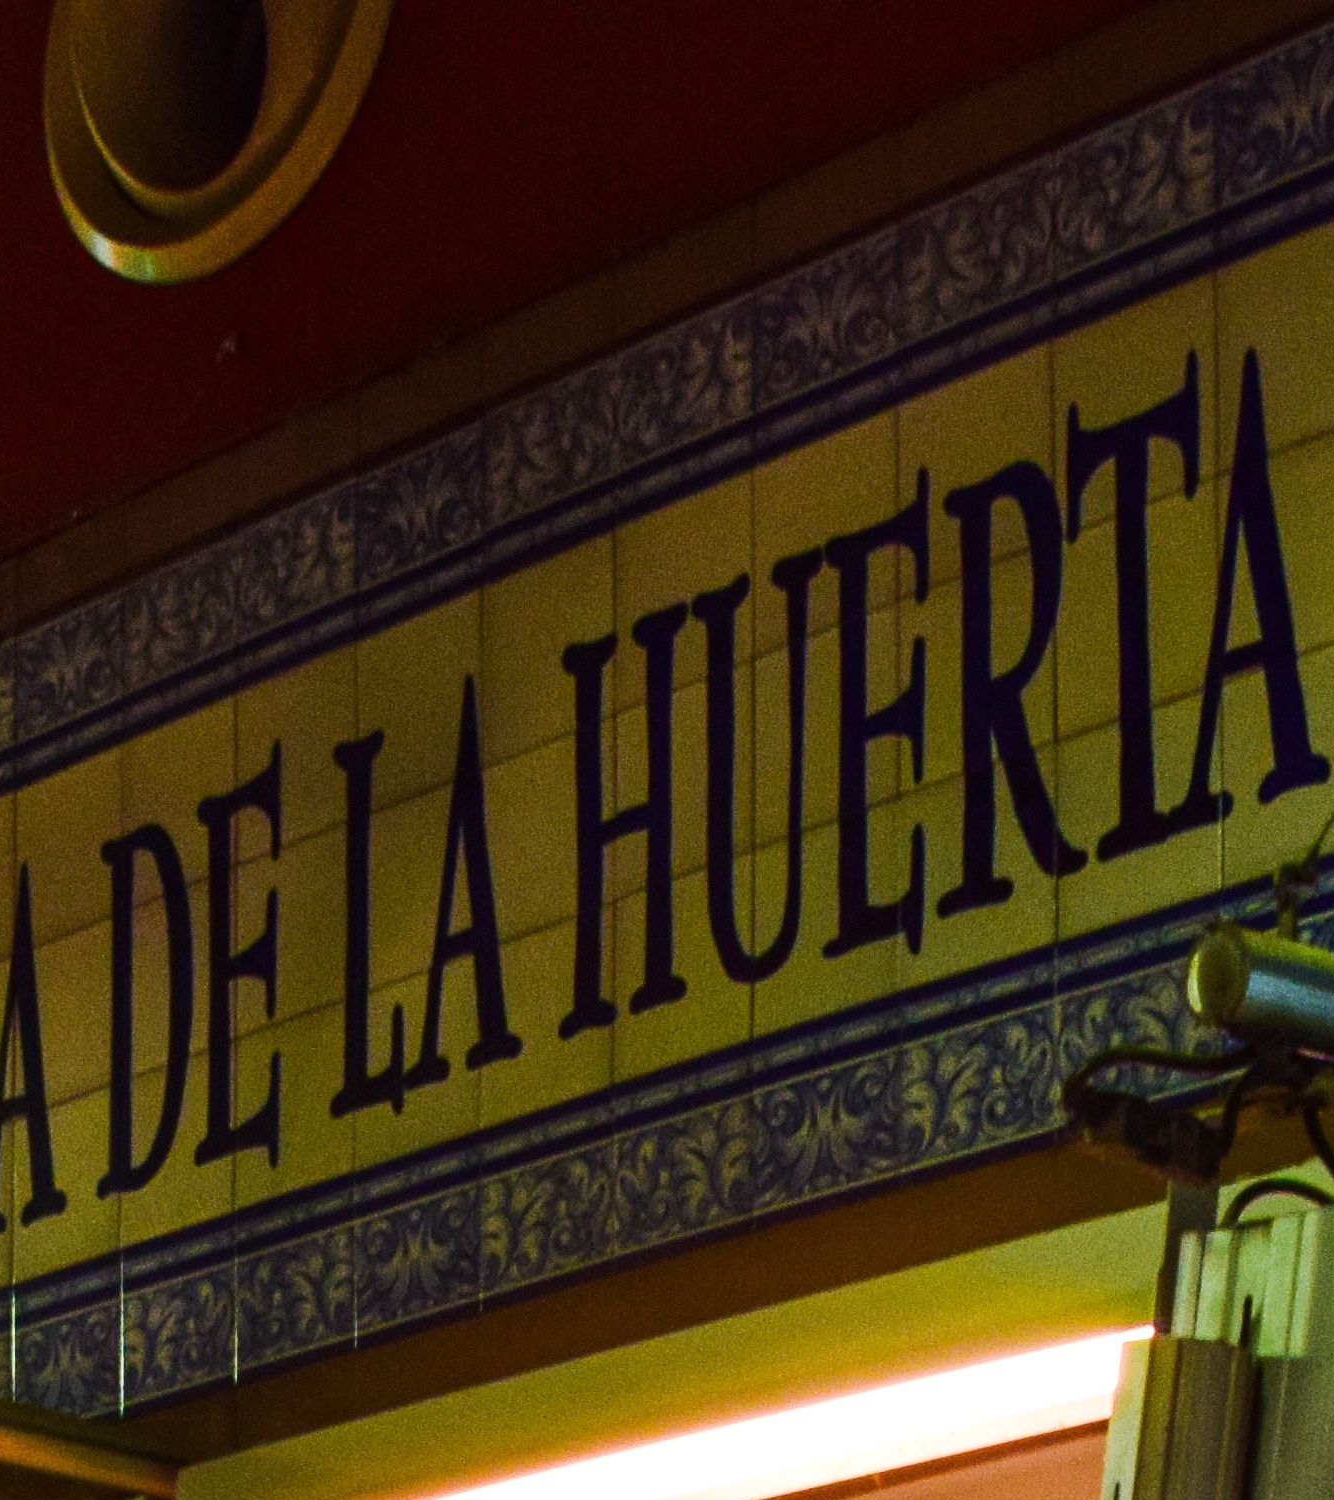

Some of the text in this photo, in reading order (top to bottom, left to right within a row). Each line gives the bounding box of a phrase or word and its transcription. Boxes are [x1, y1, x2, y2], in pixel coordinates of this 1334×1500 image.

[97, 740, 281, 1200] DE
[330, 673, 523, 1118] LA
[558, 345, 1331, 1040] HUERTA
